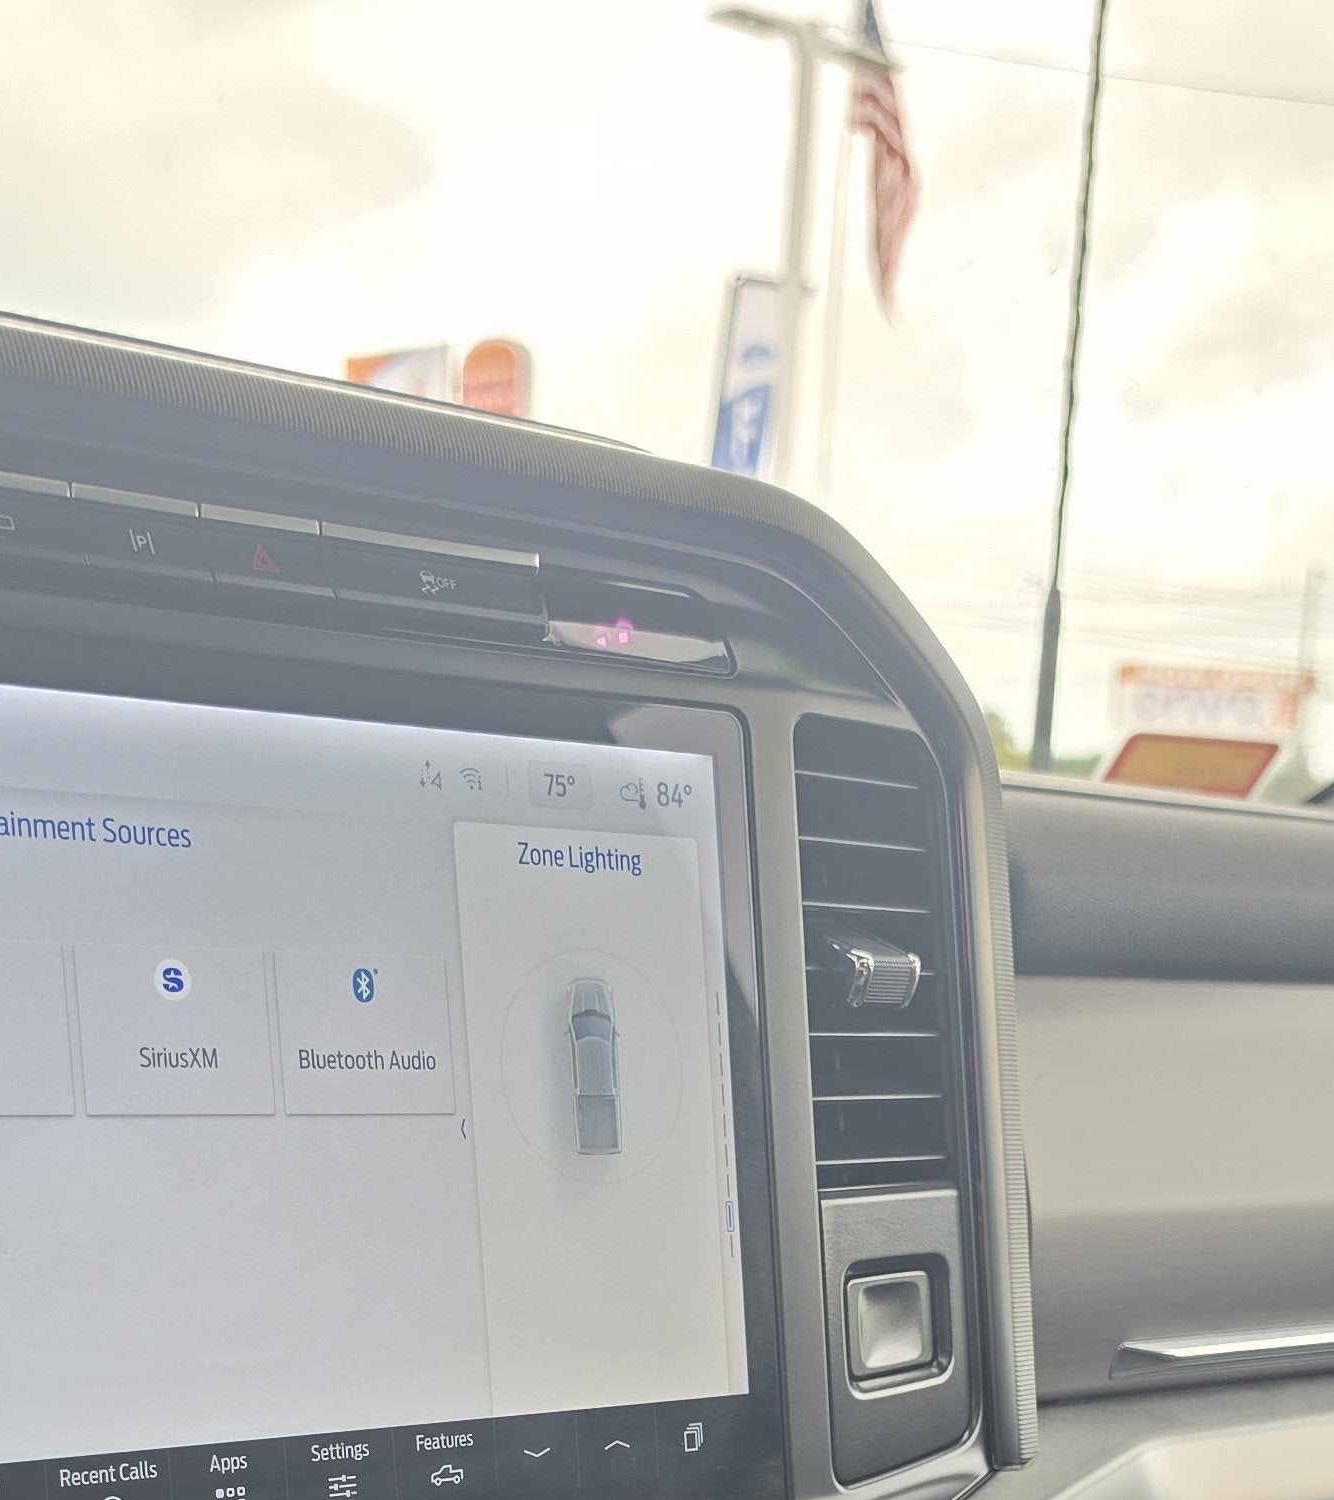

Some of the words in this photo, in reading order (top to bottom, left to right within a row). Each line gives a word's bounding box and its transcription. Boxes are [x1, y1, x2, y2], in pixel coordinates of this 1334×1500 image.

[436, 576, 457, 590] OFF
[543, 773, 576, 798] 75°
[657, 782, 692, 809] 84°
[102, 817, 192, 848] Sources
[517, 841, 564, 868] Zone
[568, 845, 642, 877] Lighting
[139, 1046, 218, 1069] SiriusXM
[298, 1048, 385, 1070] Bluetooth
[389, 1049, 436, 1071] Audio
[310, 1442, 370, 1462] Settings
[415, 1433, 474, 1452] Features
[59, 1465, 117, 1488] Recent
[119, 1460, 158, 1481] Calls
[209, 1454, 248, 1475] Apps
